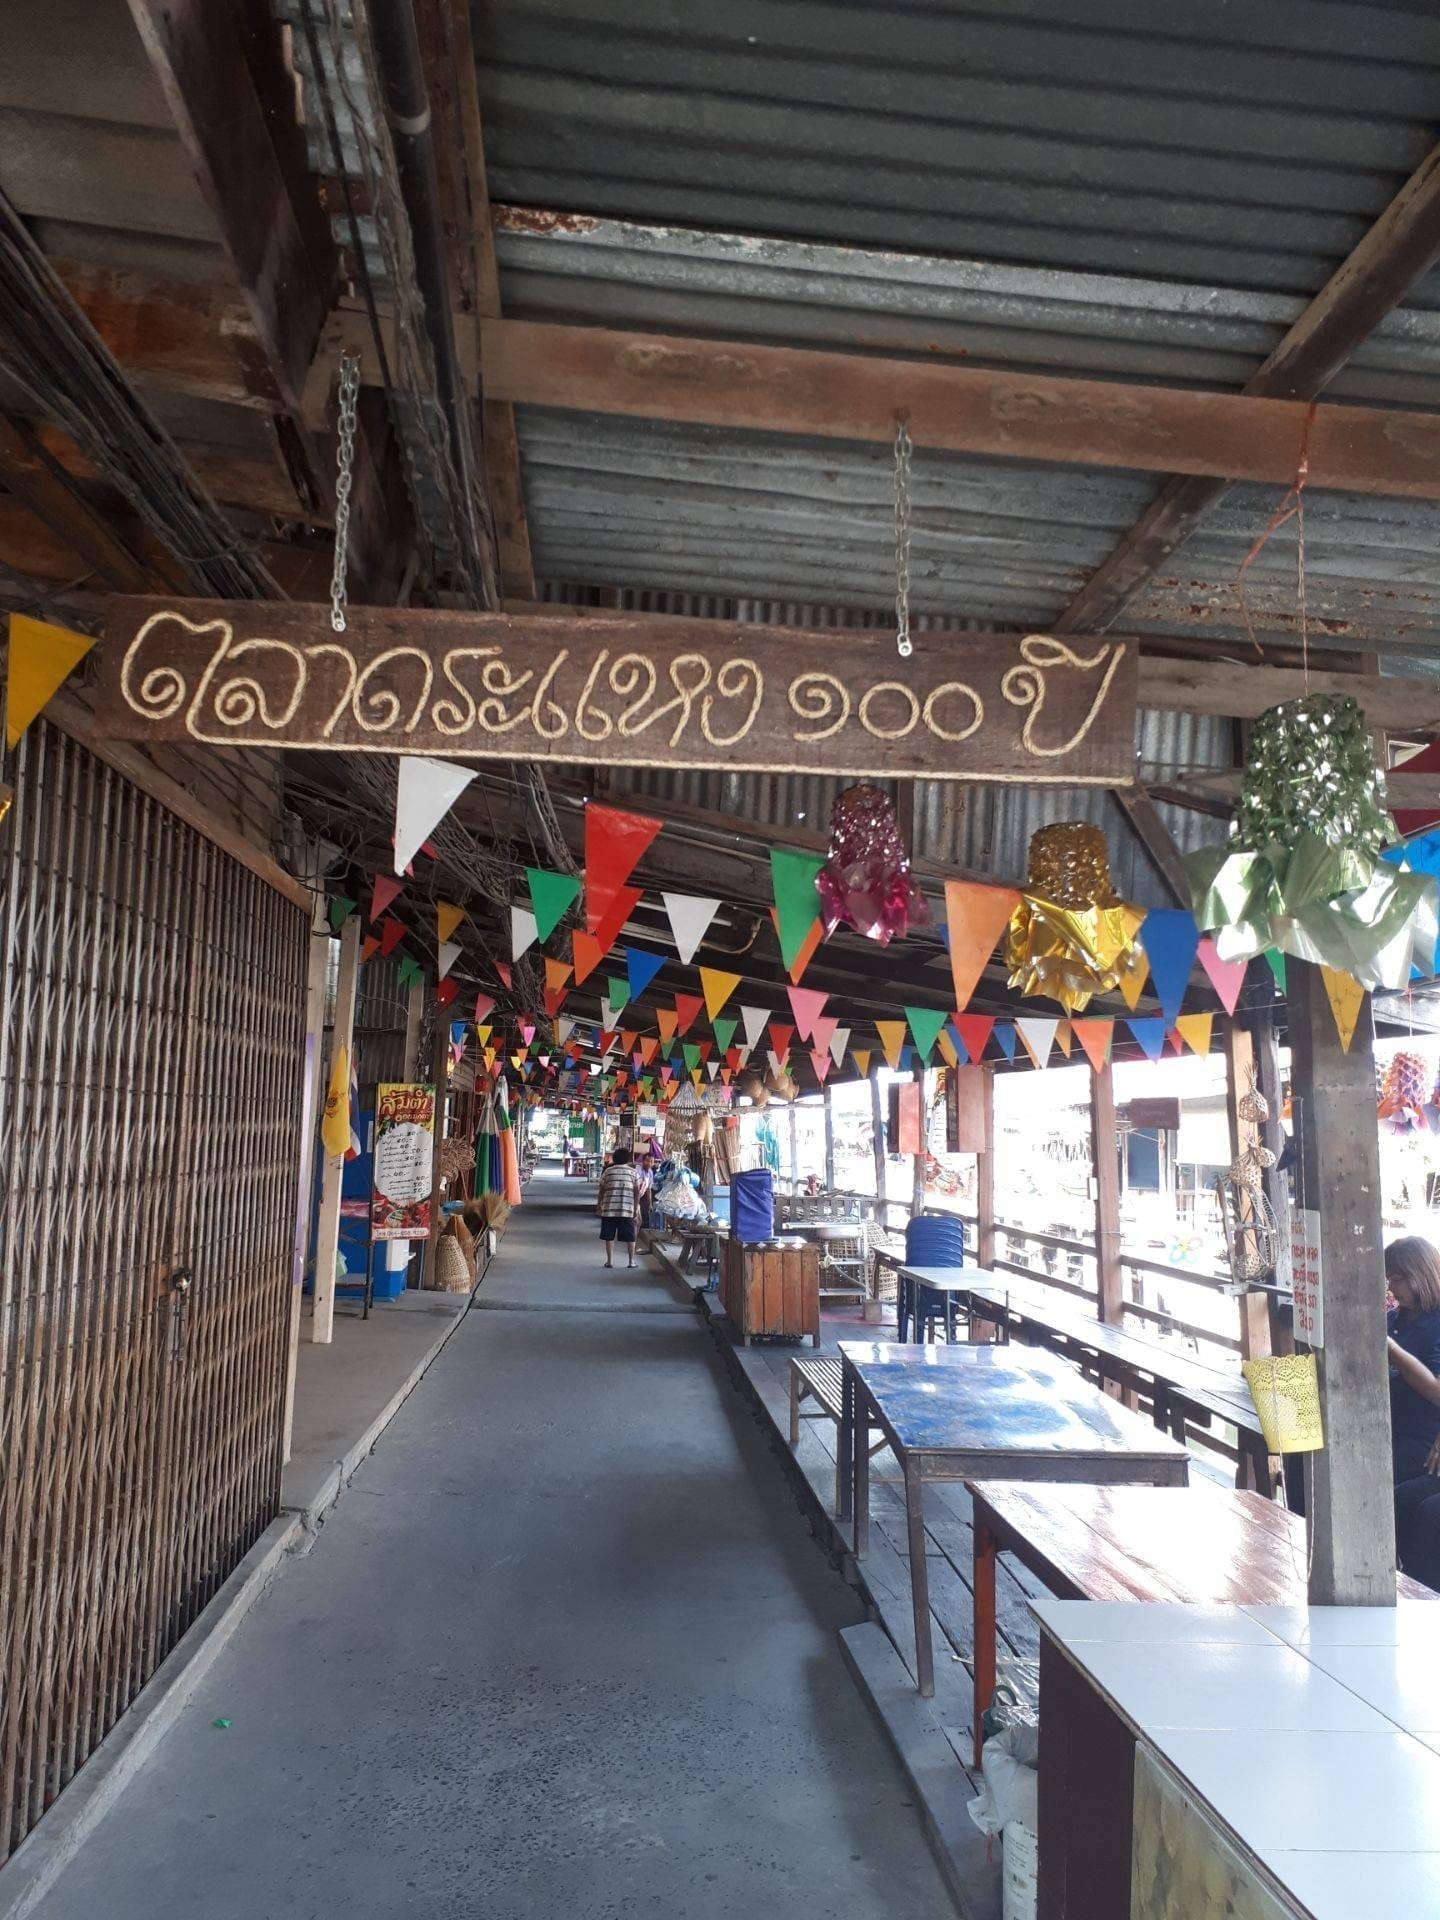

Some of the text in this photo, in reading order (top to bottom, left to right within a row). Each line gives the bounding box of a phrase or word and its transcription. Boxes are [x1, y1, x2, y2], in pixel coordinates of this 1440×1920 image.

[121, 611, 1126, 756] ตลาดระแหง ๑๐๐ ปี
[381, 1089, 428, 1114] ส้มตำ
